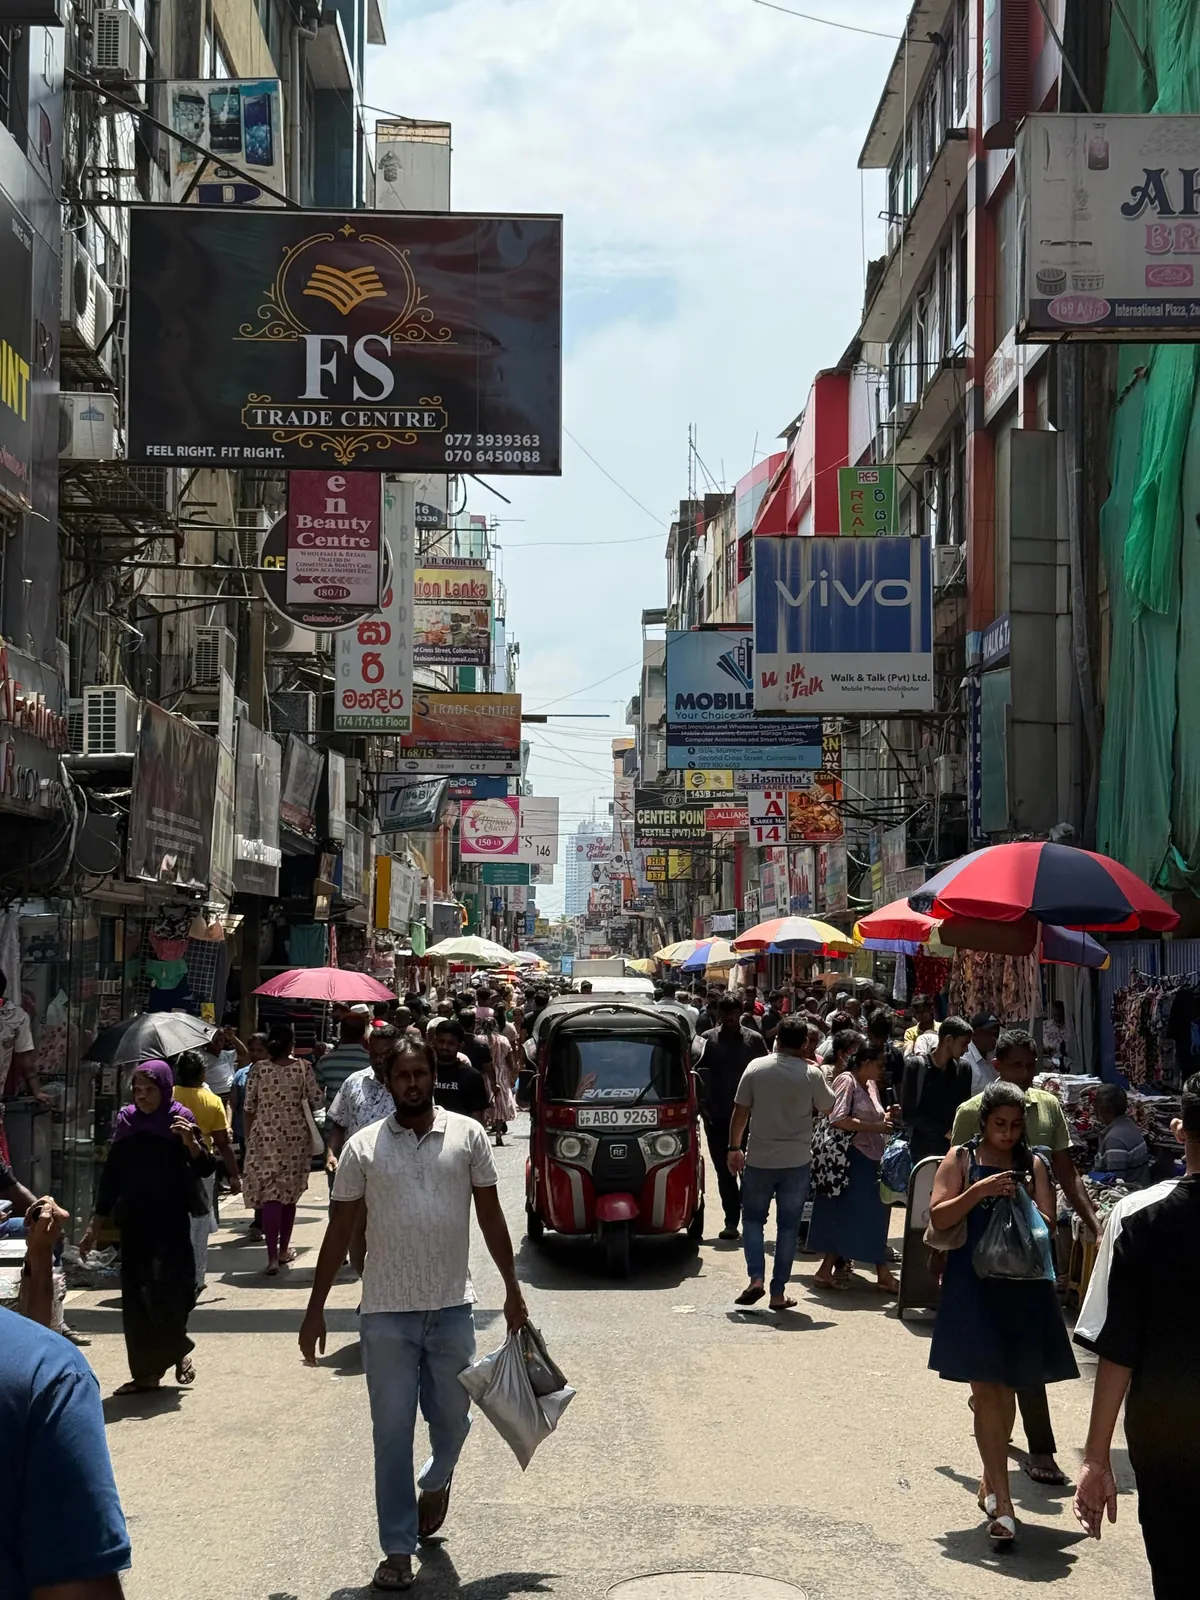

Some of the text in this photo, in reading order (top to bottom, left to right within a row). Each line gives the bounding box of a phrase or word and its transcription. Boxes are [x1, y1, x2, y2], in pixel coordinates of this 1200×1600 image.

[1115, 304, 1163, 316] International
[1165, 304, 1188, 317] Plaza,
[298, 334, 395, 402] FS
[252, 409, 437, 428] TRADE CENTRE
[444, 434, 541, 448] 077 3939363
[146, 445, 285, 459] FEEL RIGHT. FIT RIGHT.
[444, 450, 541, 463] 070 6450088
[858, 472, 878, 482] RES
[296, 515, 372, 533] Beauty
[297, 533, 371, 548] Centre
[445, 579, 488, 599] Lanka
[774, 569, 914, 607] vivo
[831, 674, 930, 683] Walk & Talk (Pvt) Ltd.
[791, 676, 824, 699] Talk
[433, 705, 469, 715] TRADE
[475, 705, 516, 716] CENTRE
[338, 716, 353, 726] 174
[386, 717, 407, 727] Floor
[402, 748, 434, 758] 168/15
[751, 774, 812, 784] Hasmitha's
[637, 809, 704, 825] CENTER POIN
[641, 828, 670, 837] TEXTILE
[672, 829, 690, 838] (PVT)
[636, 838, 653, 846] 144
[536, 845, 550, 856] 146
[586, 850, 609, 861] Galler
[650, 857, 663, 865] HR
[580, 1110, 656, 1125] WP ABO 9263
